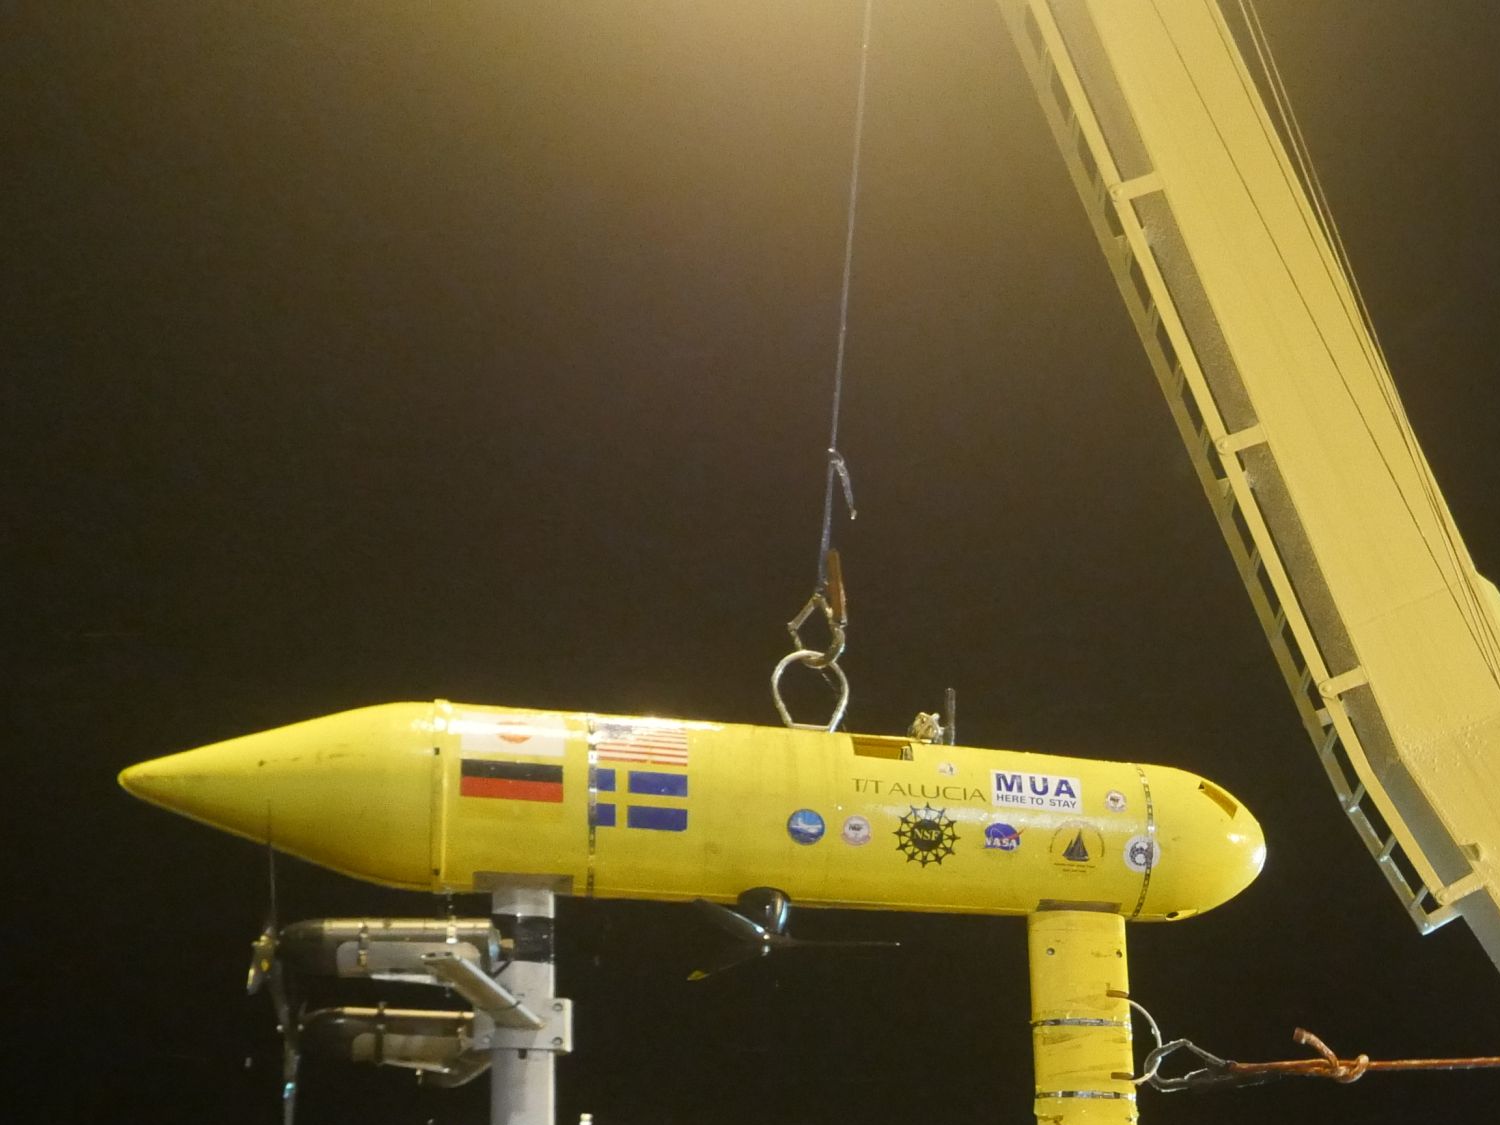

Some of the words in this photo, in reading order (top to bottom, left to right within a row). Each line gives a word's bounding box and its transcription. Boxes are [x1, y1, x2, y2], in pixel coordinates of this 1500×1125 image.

[888, 782, 986, 802] ALUCIA
[995, 773, 1076, 798] MUA
[996, 793, 1027, 805] HERE
[1029, 796, 1044, 806] TO
[1049, 798, 1077, 809] STAY
[913, 828, 941, 841] NSF
[985, 836, 1018, 848] NASA
